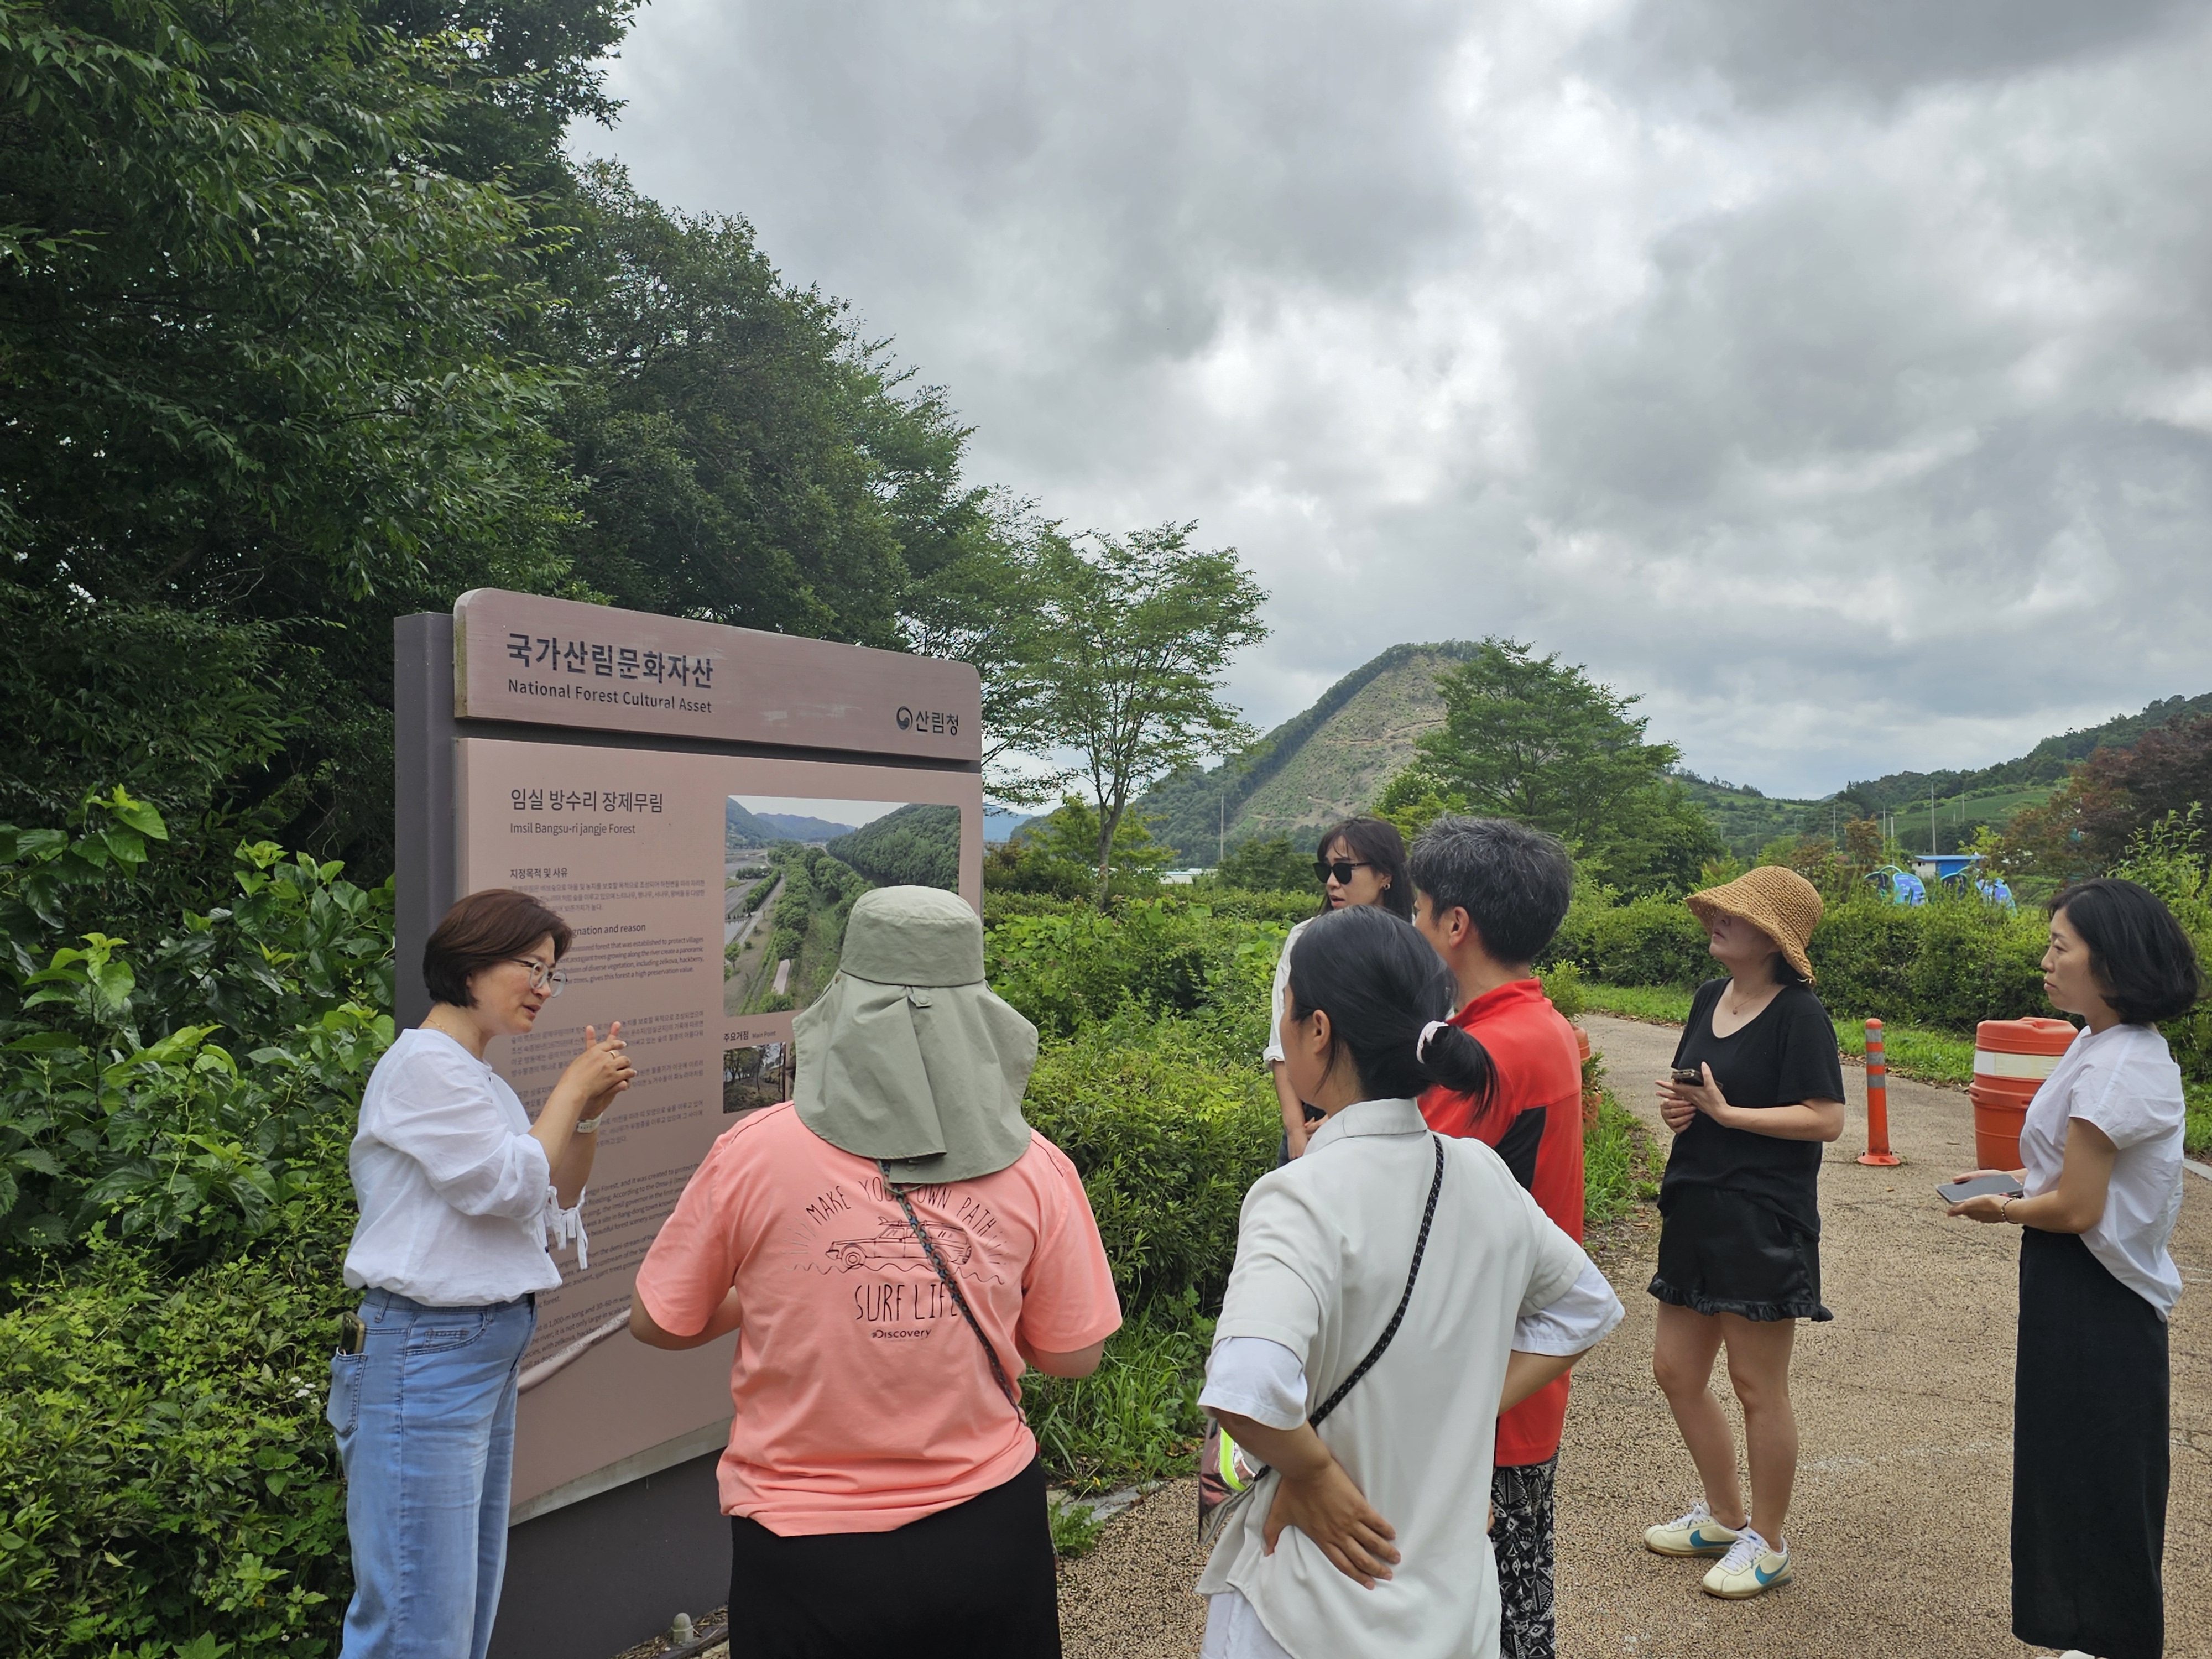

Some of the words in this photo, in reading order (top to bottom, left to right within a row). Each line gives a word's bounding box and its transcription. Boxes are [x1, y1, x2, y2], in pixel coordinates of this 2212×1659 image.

[507, 633, 713, 689] 국가산림문화자산
[508, 678, 571, 698] National
[576, 686, 618, 703] Forest
[623, 690, 675, 709] Cultural
[679, 697, 712, 713] Asset
[915, 709, 959, 736] 산림청
[512, 789, 543, 810] 임실
[550, 790, 597, 811] 방수리
[602, 791, 662, 813] 장제무림
[510, 823, 533, 833] Imsil
[535, 823, 578, 836] Bangsu-ri
[580, 824, 607, 836] jangje
[608, 824, 635, 833] Forest
[510, 868, 541, 879] 지정목적
[544, 868, 551, 878] 및
[554, 868, 568, 878] 사유
[604, 924, 618, 933] and
[648, 968, 679, 977] preservation
[723, 1031, 749, 1042] 주요거점
[648, 1170, 667, 1180] created
[675, 1164, 693, 1173] protect
[613, 1188, 639, 1199] According
[626, 1196, 648, 1207] governor
[618, 1206, 645, 1219] Bang-dong
[806, 1185, 851, 1226] MAKE
[957, 1197, 997, 1236] PATH
[629, 1217, 648, 1225] scenery
[855, 1284, 905, 1322] SURF
[549, 1315, 571, 1327] 1,000-m
[572, 1310, 584, 1319] long
[566, 1324, 575, 1332] not
[576, 1319, 588, 1329] only
[588, 1314, 602, 1324] large
[609, 1308, 622, 1317] scale
[542, 1342, 554, 1350] with
[555, 1334, 576, 1347] zelkova,
[876, 1329, 932, 1339] Discovery
[541, 1348, 568, 1362] dogwood
[570, 1343, 580, 1351] and
